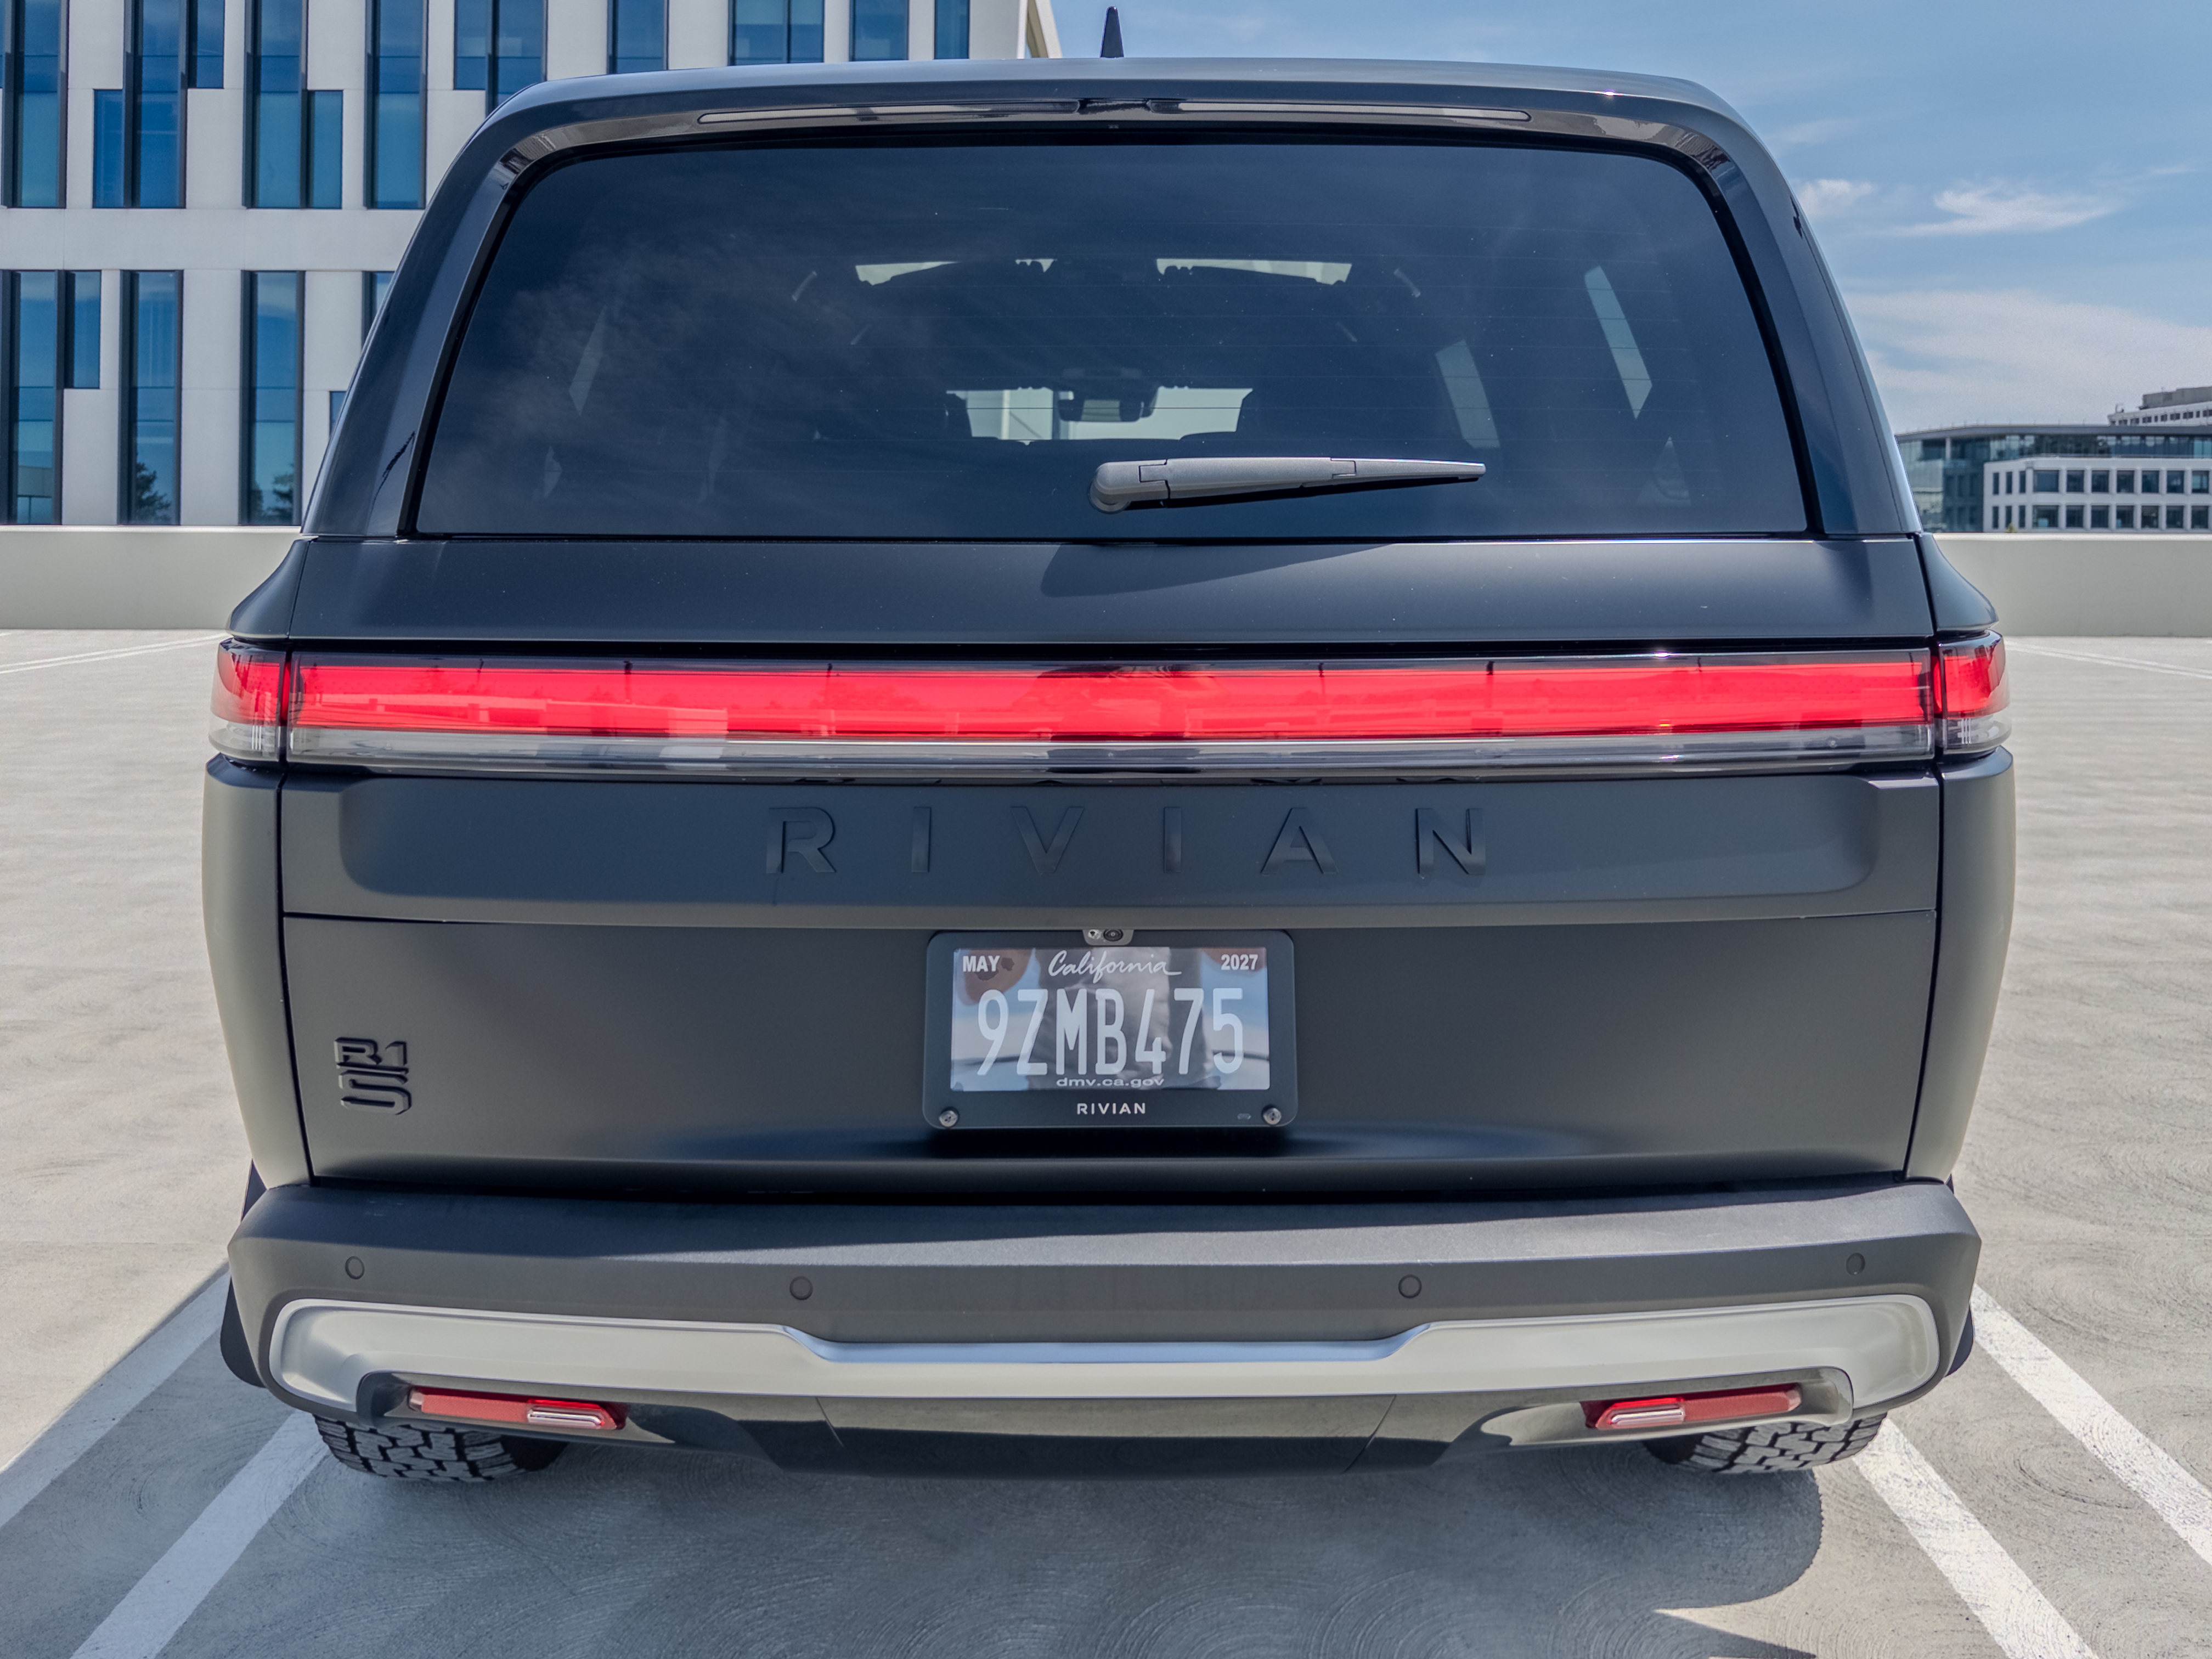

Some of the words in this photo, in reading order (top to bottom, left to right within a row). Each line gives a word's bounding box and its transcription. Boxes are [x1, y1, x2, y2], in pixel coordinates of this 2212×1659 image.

[766, 807, 1486, 875] RIVIAN
[962, 955, 1000, 972] MAY
[1048, 950, 1182, 984] California
[1221, 954, 1258, 970] 2027
[977, 988, 1244, 1076] 9ZMB475
[1056, 1076, 1165, 1088] dmv.ca.gov
[1077, 1102, 1146, 1115] RIVIAN
